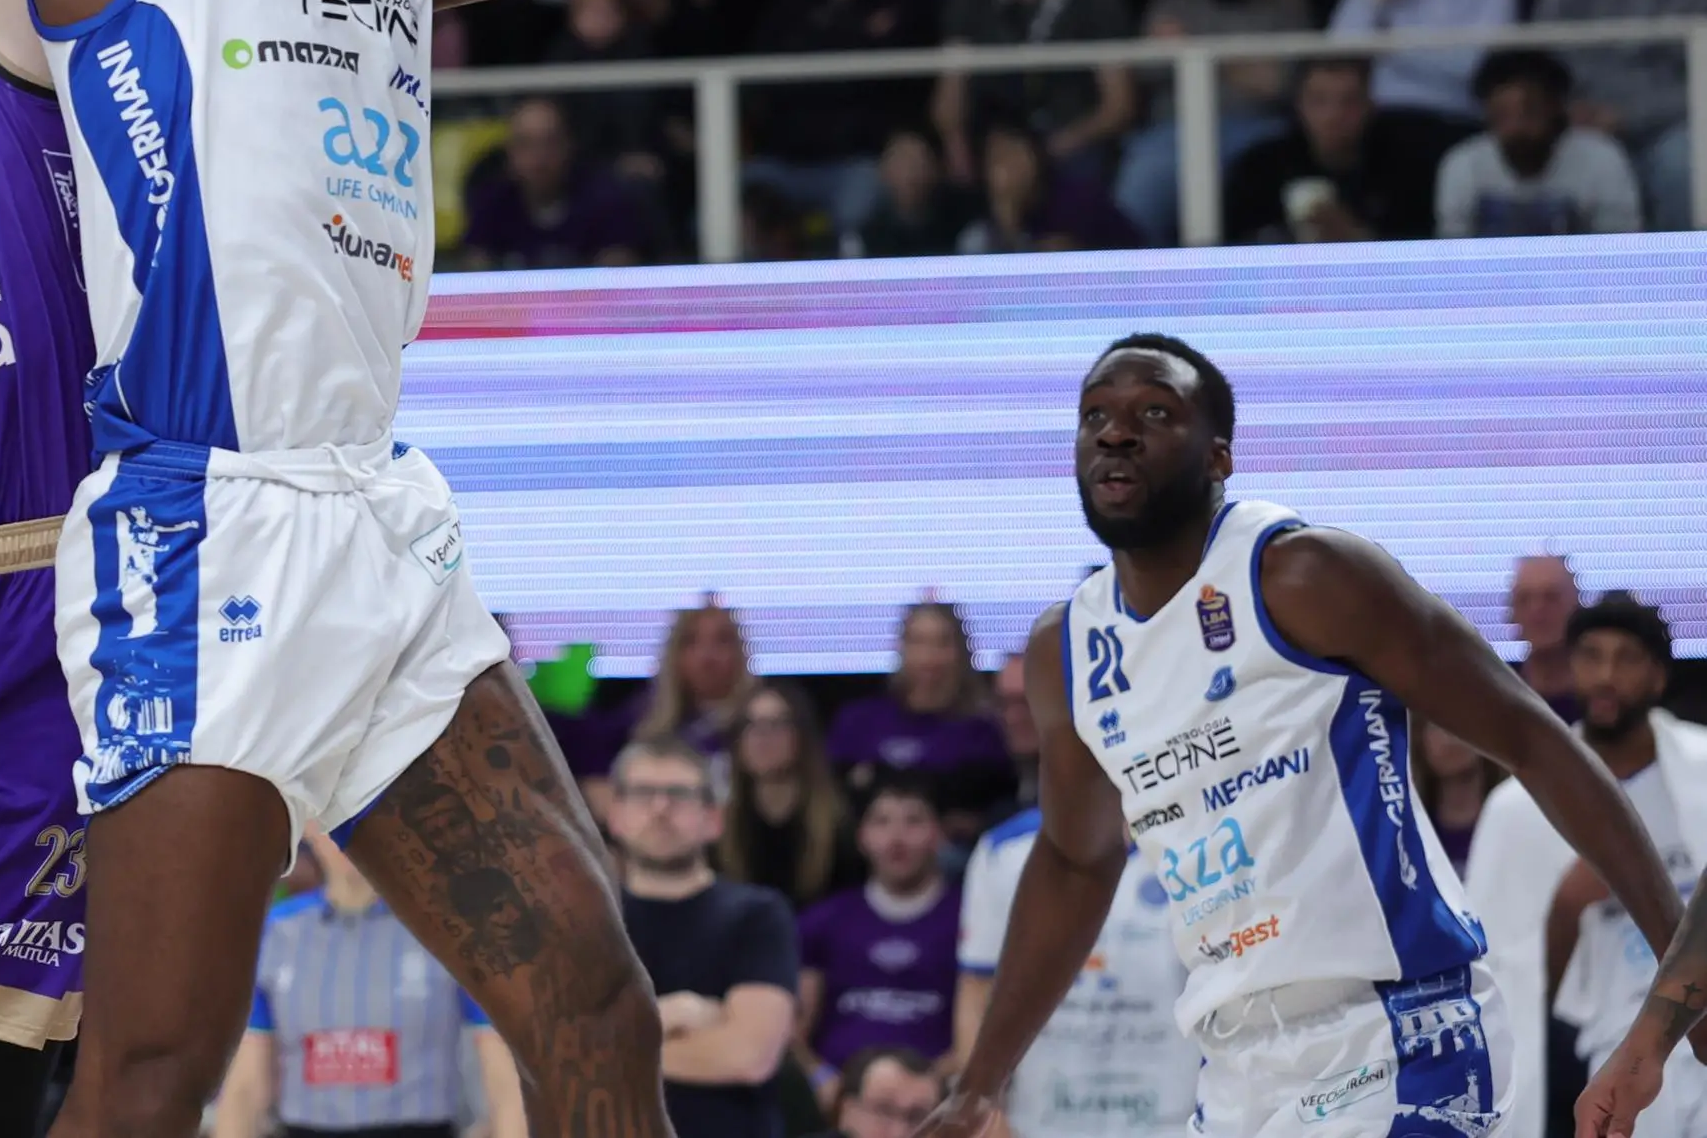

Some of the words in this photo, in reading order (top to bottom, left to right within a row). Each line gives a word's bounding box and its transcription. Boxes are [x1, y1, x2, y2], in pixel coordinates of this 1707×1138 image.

[96, 39, 176, 206] GERMANI
[326, 176, 363, 200] LIFE
[1087, 624, 1132, 703] 21
[24, 825, 89, 898] 23
[2, 945, 60, 967] MUTUA
[11, 918, 86, 955] ITAS
